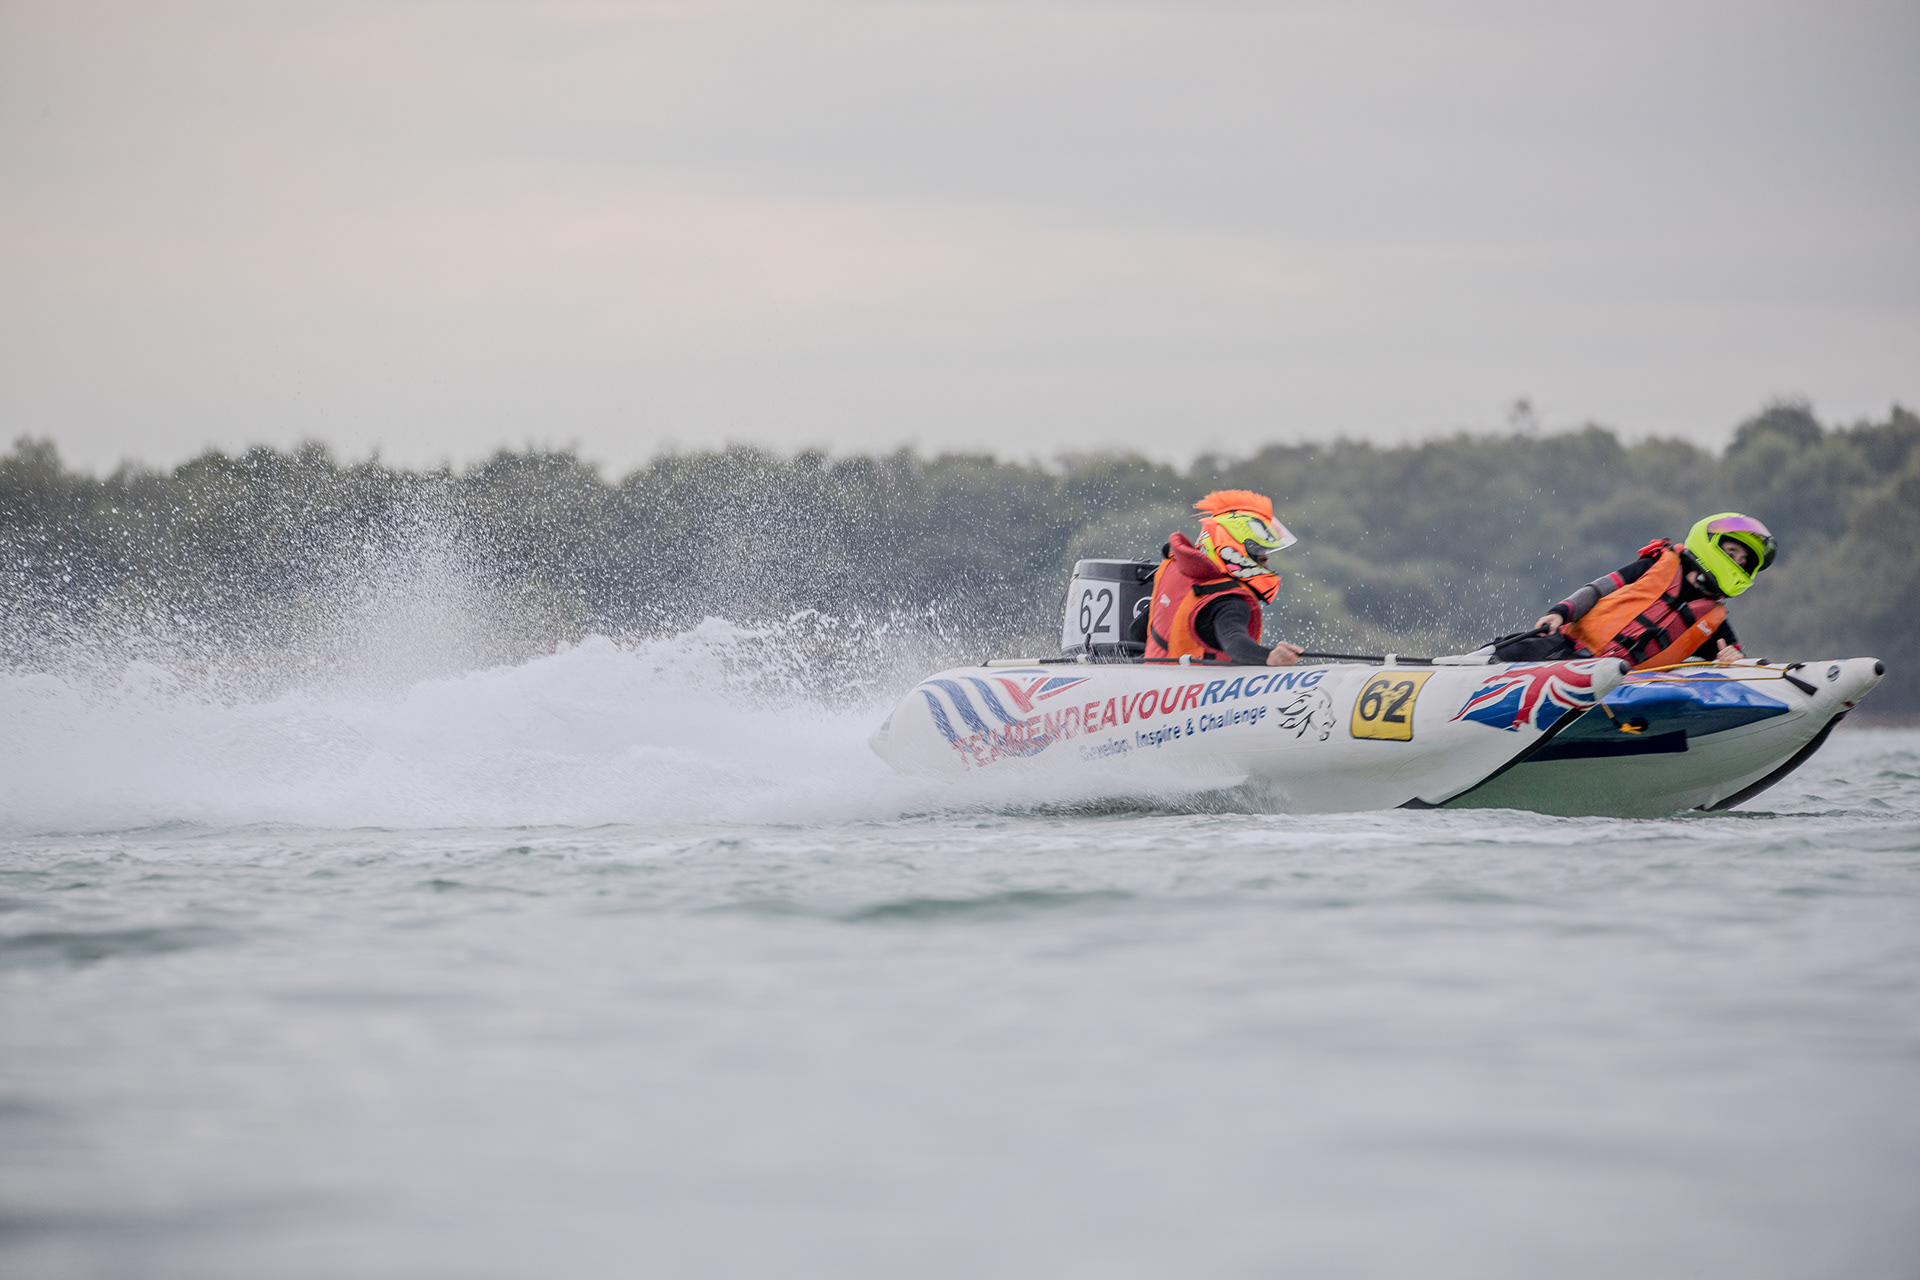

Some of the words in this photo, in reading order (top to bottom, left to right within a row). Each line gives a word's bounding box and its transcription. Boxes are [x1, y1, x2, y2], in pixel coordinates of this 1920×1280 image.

[1080, 589, 1113, 634] 62
[1360, 680, 1414, 723] 62
[1136, 724, 1181, 748] Inspire
[1185, 718, 1195, 736] &
[1200, 705, 1267, 732] Challenge
